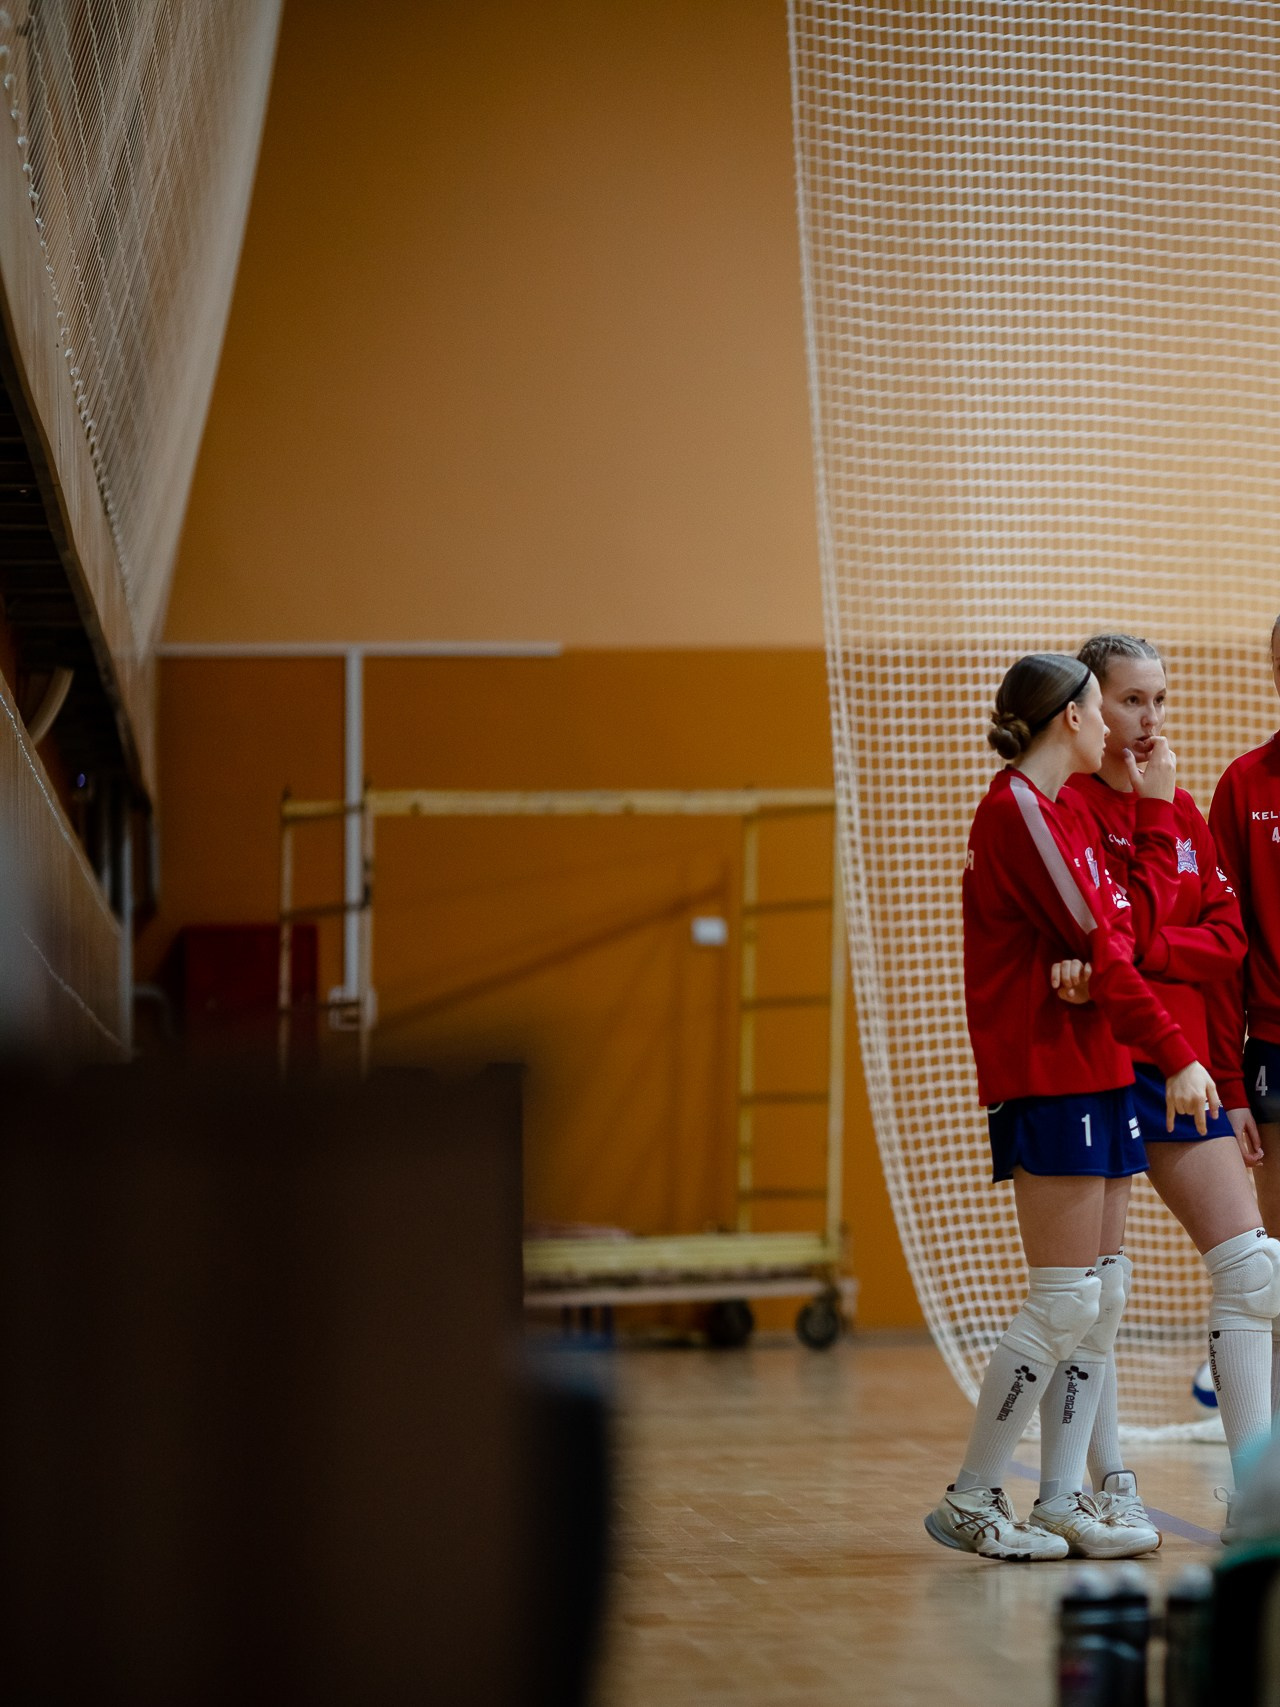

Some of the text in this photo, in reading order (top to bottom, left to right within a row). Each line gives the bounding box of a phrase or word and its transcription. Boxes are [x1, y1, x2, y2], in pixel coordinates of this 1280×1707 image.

[1271, 826, 1280, 843] 4
[1255, 1065, 1268, 1097] 4
[1081, 1113, 1092, 1147] 1
